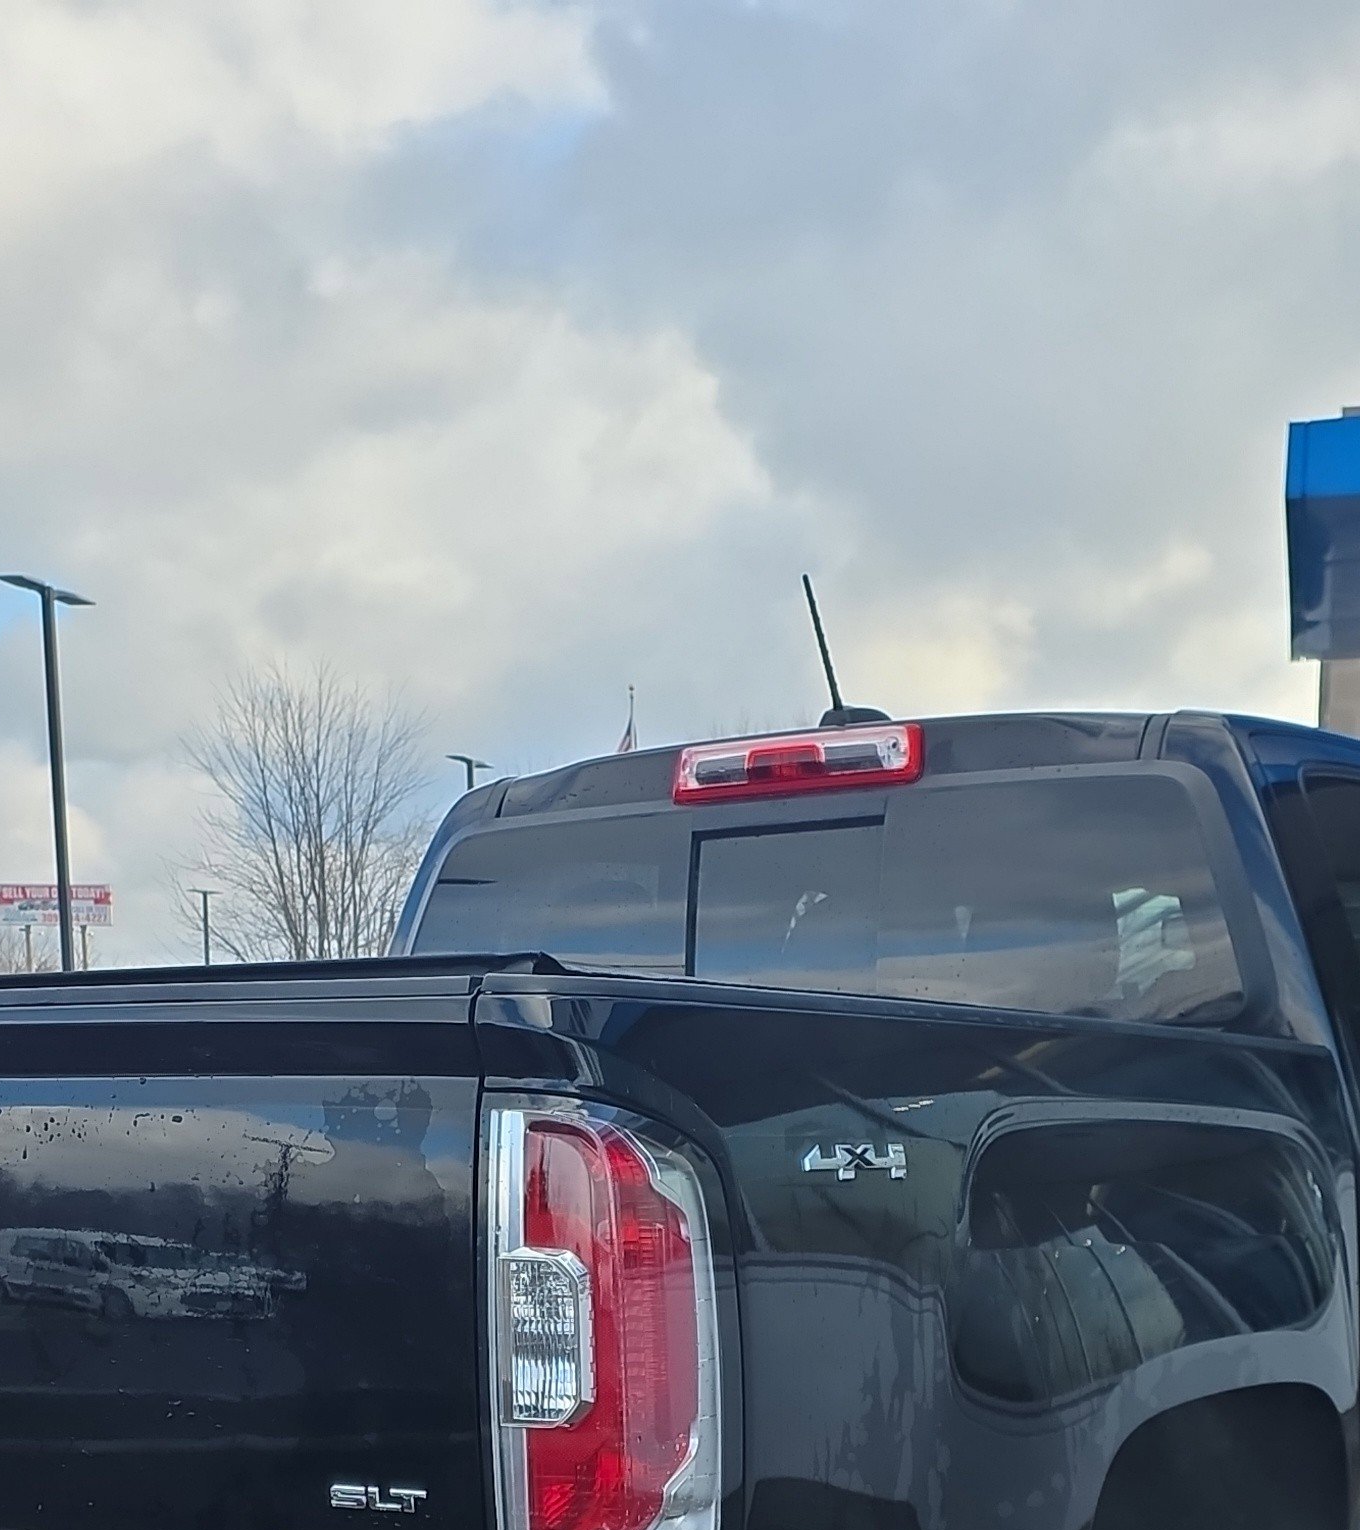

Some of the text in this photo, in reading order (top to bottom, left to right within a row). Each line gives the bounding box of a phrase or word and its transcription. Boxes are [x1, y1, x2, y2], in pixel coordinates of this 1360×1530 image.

[2, 887, 24, 899] SELL
[25, 887, 50, 899] YOUR
[330, 1485, 427, 1513] SLT
